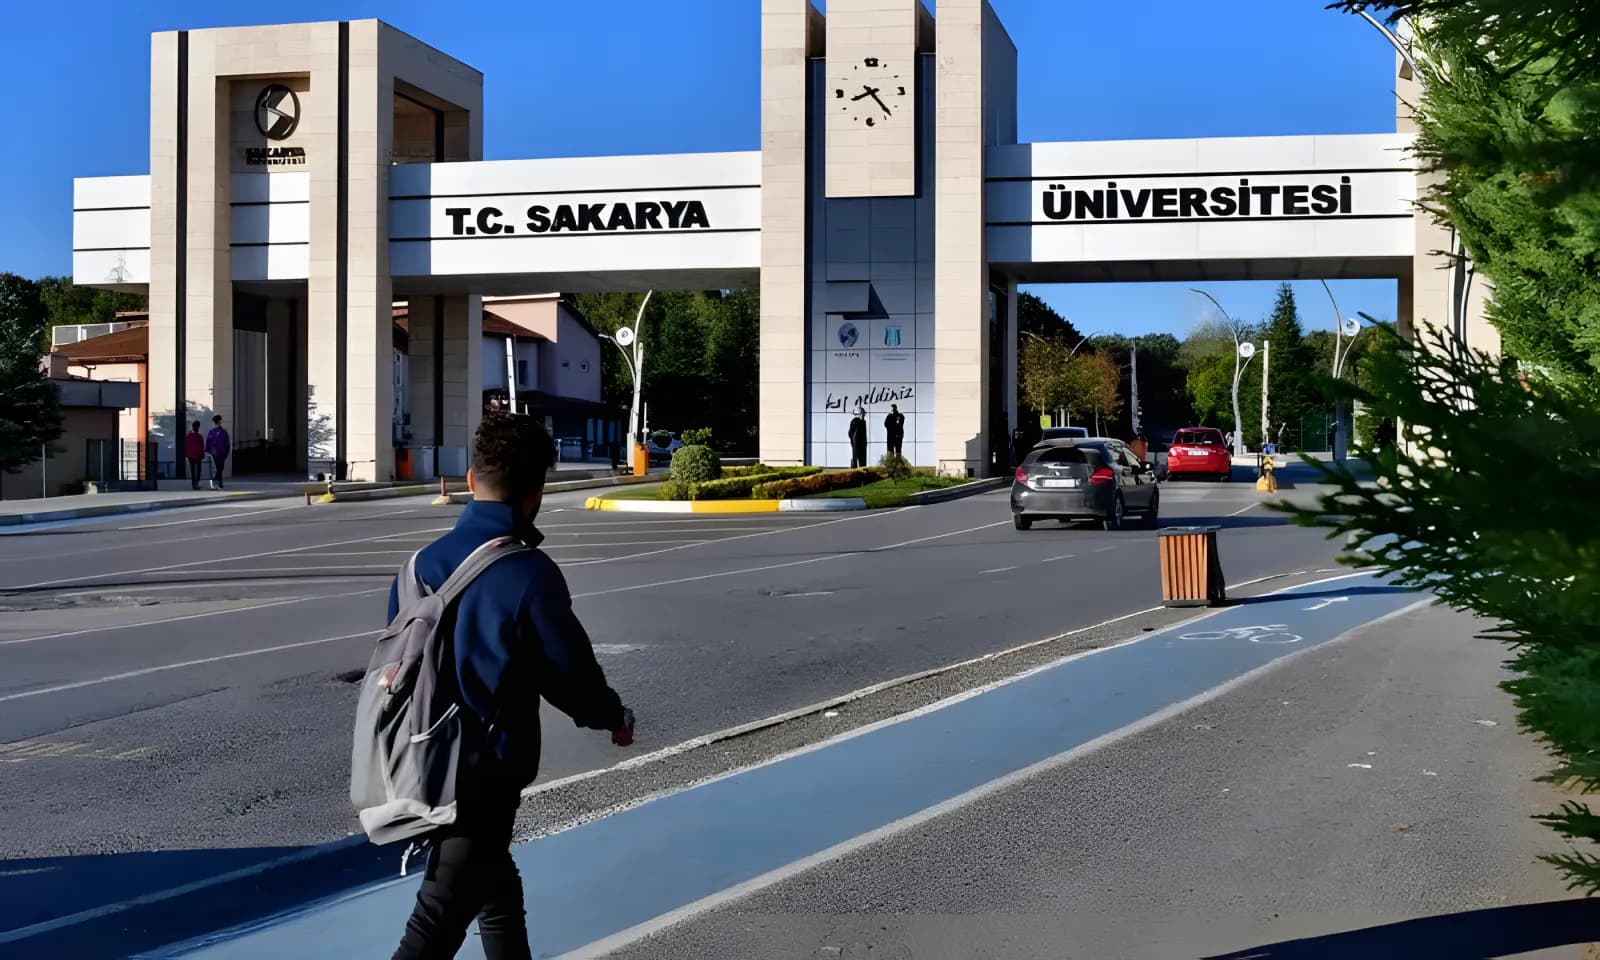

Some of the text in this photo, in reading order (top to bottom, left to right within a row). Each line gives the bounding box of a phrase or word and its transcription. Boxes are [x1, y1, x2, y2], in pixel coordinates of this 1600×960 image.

[1042, 175, 1353, 220] ÜNİVERSİTESİ
[445, 200, 711, 236] T.C. SAKARYA
